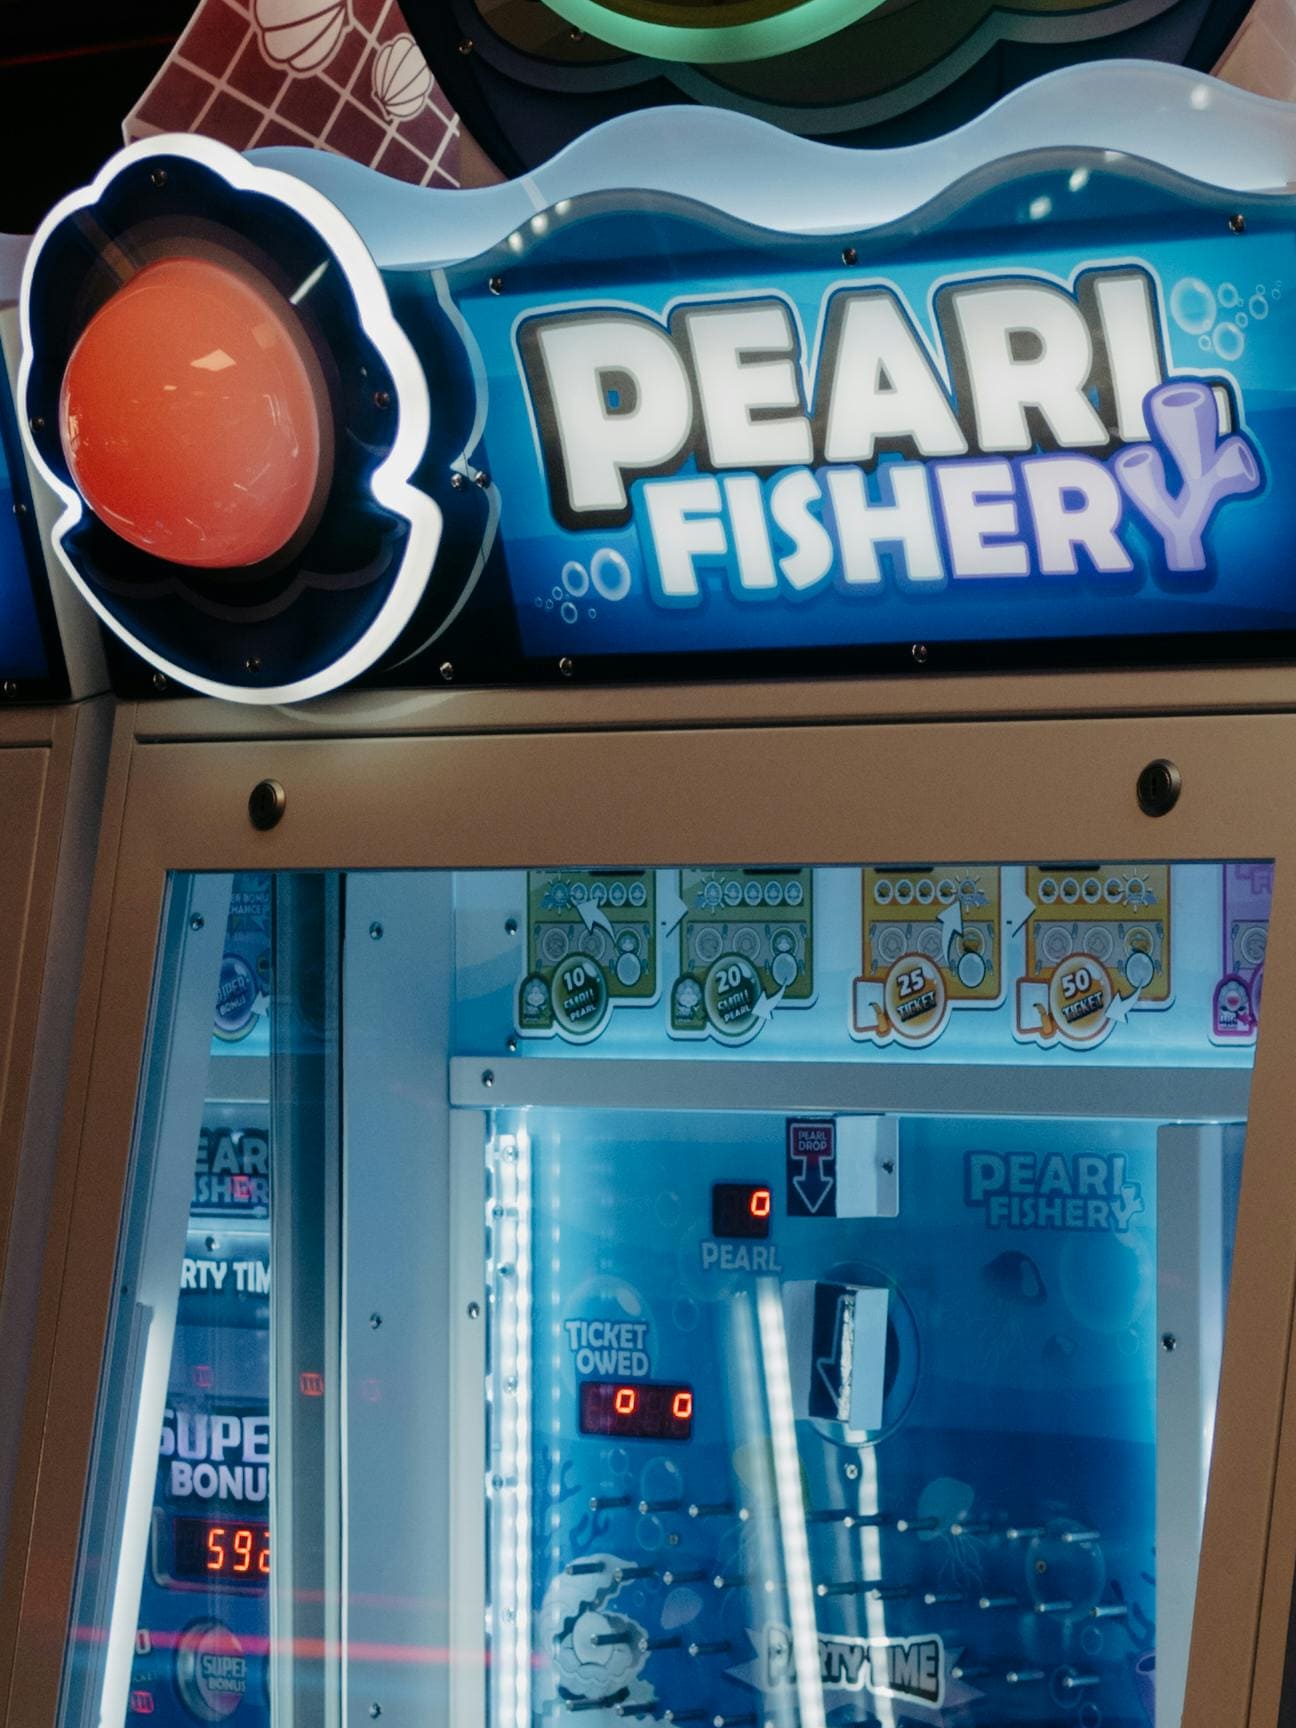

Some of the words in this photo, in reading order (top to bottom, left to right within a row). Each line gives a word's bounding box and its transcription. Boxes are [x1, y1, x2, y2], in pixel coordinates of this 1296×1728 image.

[534, 269, 1232, 514] PEARL
[647, 384, 1257, 598] FISHERY
[562, 966, 586, 991] 10
[714, 966, 744, 991] 20
[896, 968, 924, 997] 25
[1060, 968, 1091, 997] 50
[895, 990, 937, 1023] TICKET
[1059, 990, 1105, 1024] TICKET
[798, 1130, 828, 1141] PEARL
[798, 1140, 828, 1152] DROP
[968, 1153, 1126, 1203] PEARL
[750, 1190, 771, 1217] 0
[989, 1182, 1144, 1232] FISHERY
[700, 1241, 783, 1273] PEARL
[565, 1320, 648, 1350] TICKET
[576, 1347, 649, 1377] OWED
[615, 1388, 635, 1414] 0
[672, 1392, 693, 1419] 0
[170, 1460, 270, 1503] BONU
